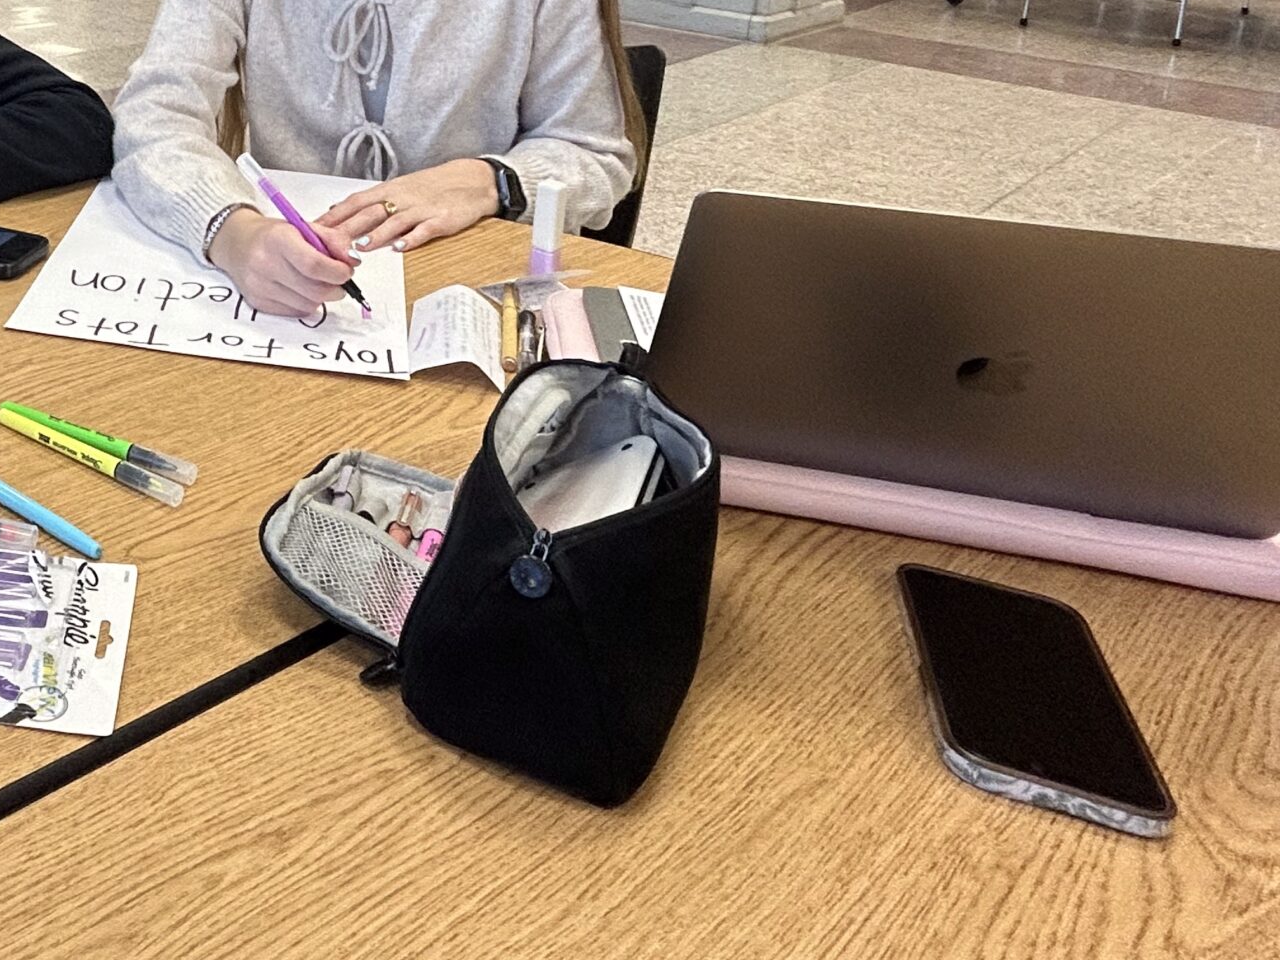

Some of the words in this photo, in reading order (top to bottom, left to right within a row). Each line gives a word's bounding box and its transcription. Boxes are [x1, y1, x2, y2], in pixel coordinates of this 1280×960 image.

[55, 308, 169, 347] Tots
[187, 334, 283, 359] For
[303, 341, 408, 375] Toys
[55, 562, 100, 648] Sharpie
